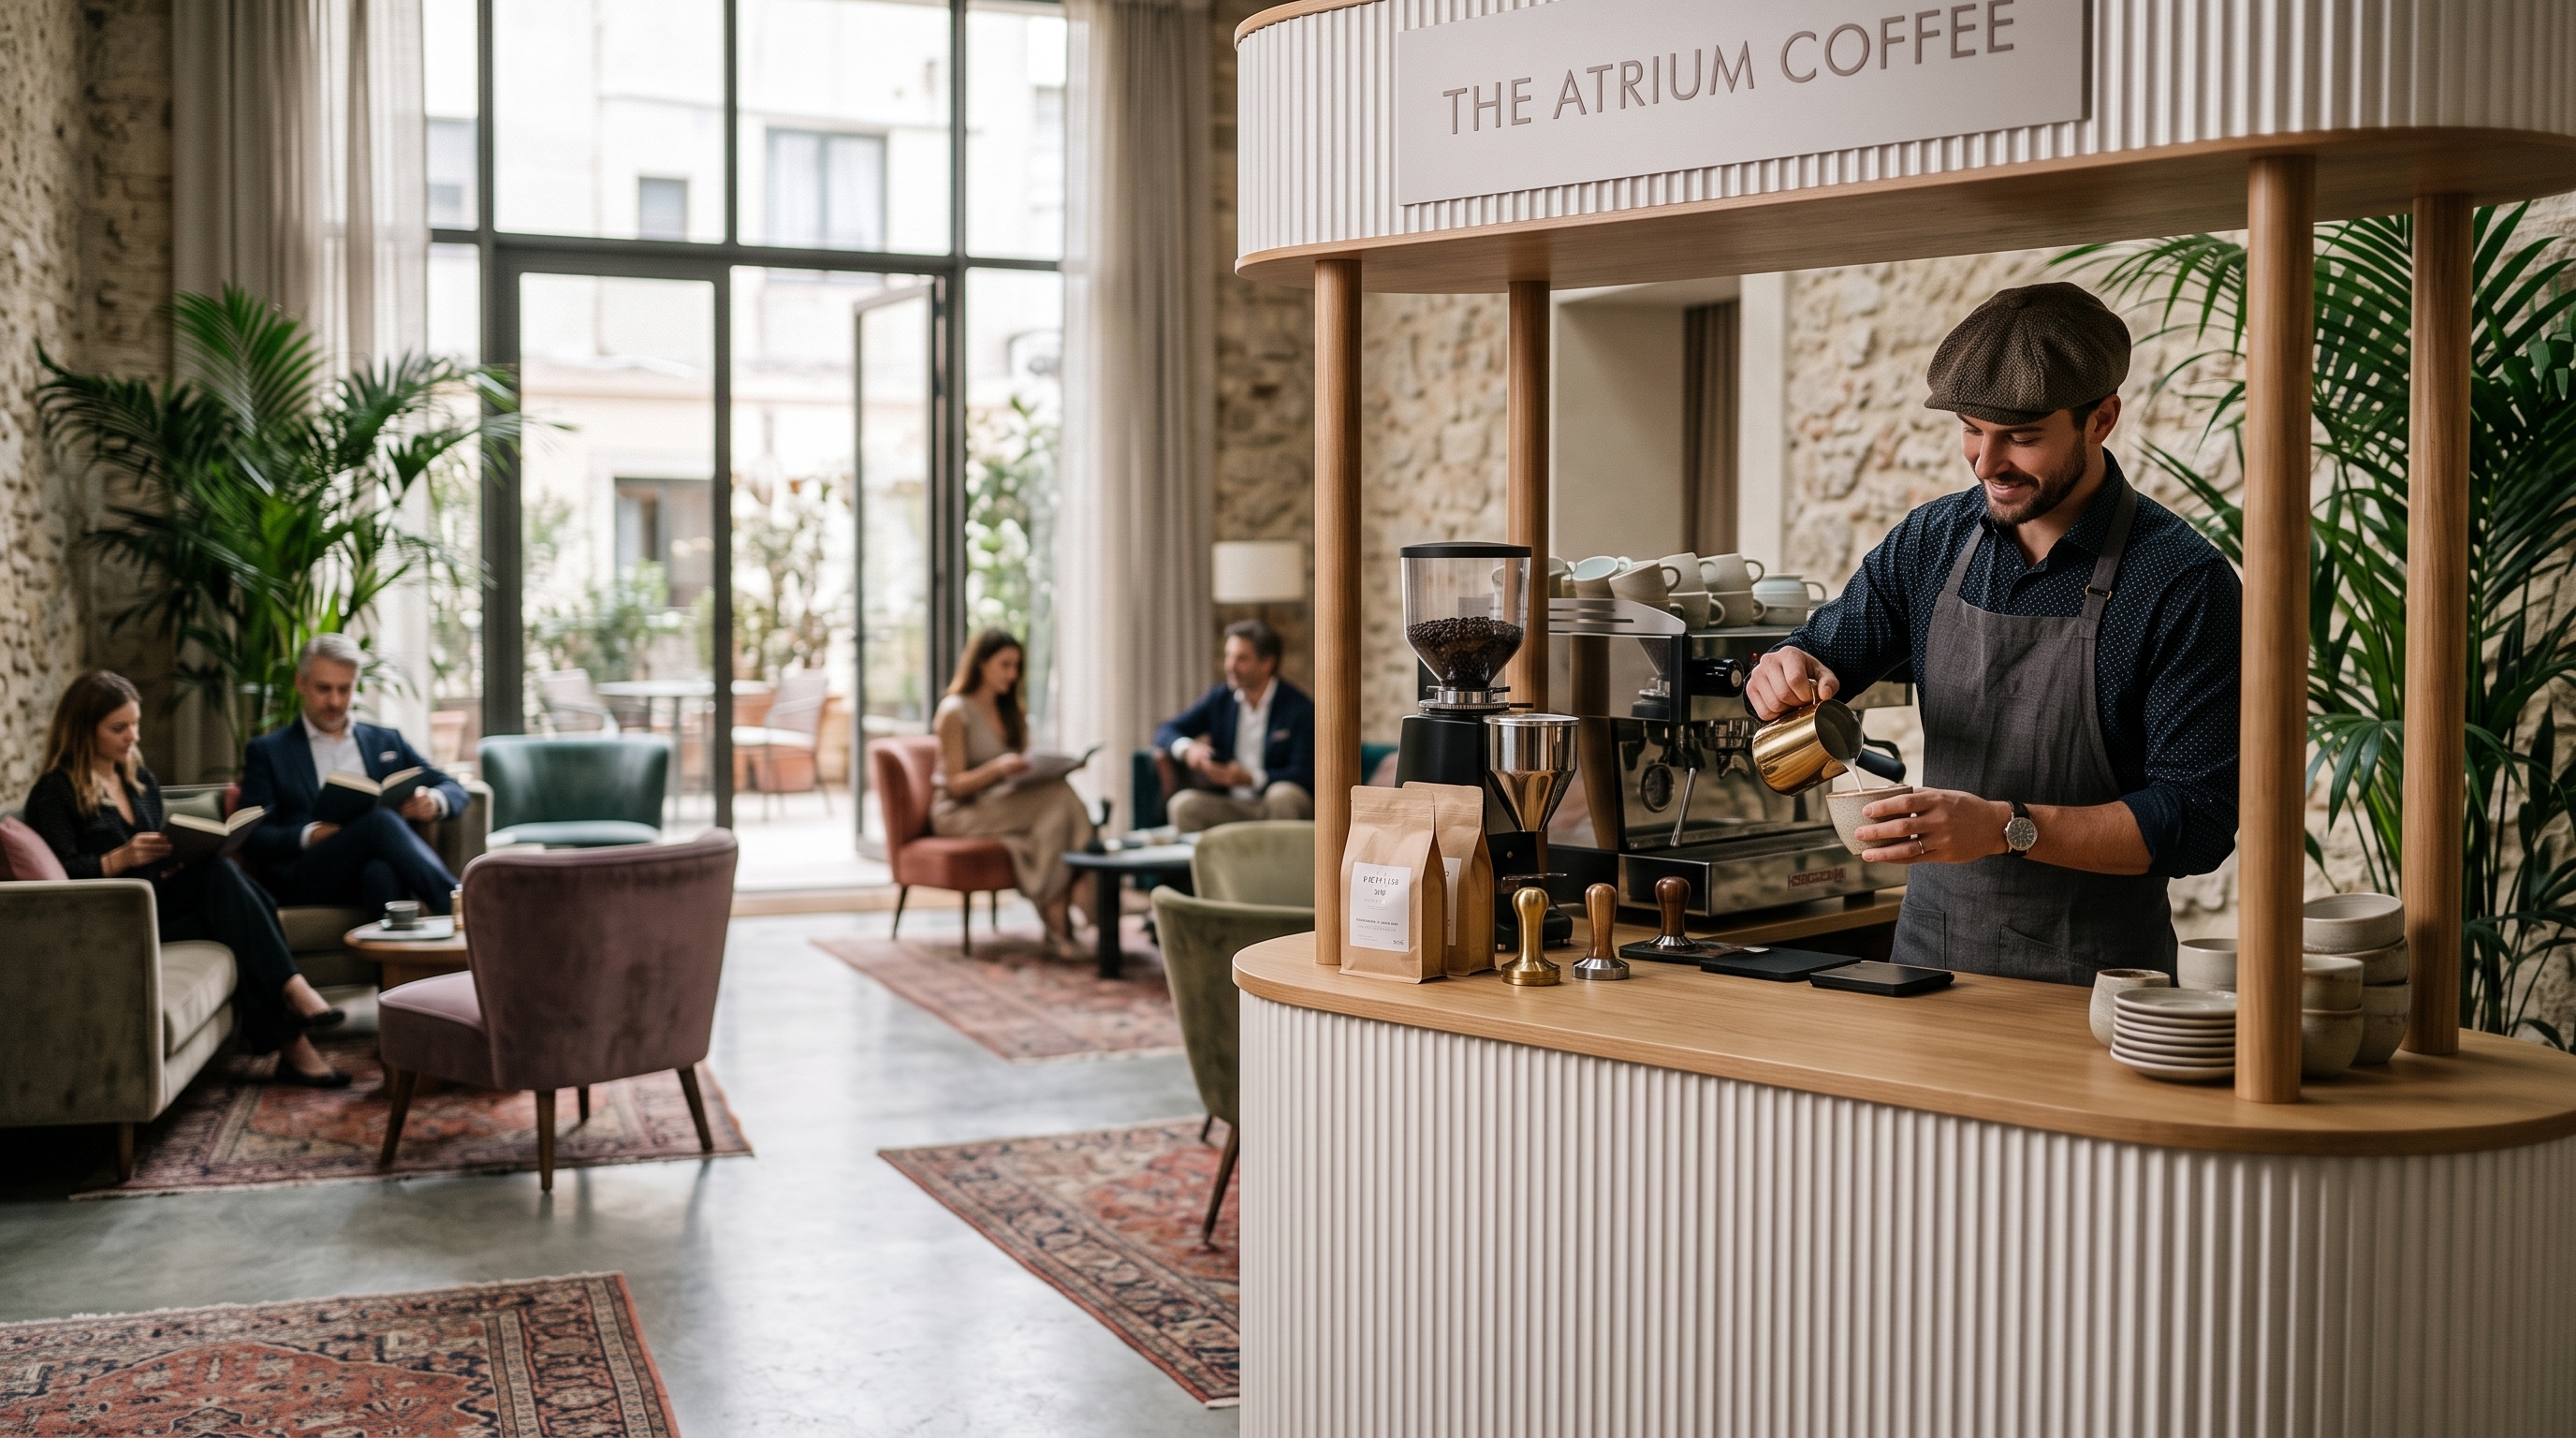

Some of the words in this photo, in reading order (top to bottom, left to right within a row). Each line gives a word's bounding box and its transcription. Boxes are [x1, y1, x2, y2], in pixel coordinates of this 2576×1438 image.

[1442, 76, 1532, 136] THE
[1552, 39, 1755, 120] ATRIUM
[1779, 0, 2015, 84] COFFEE
